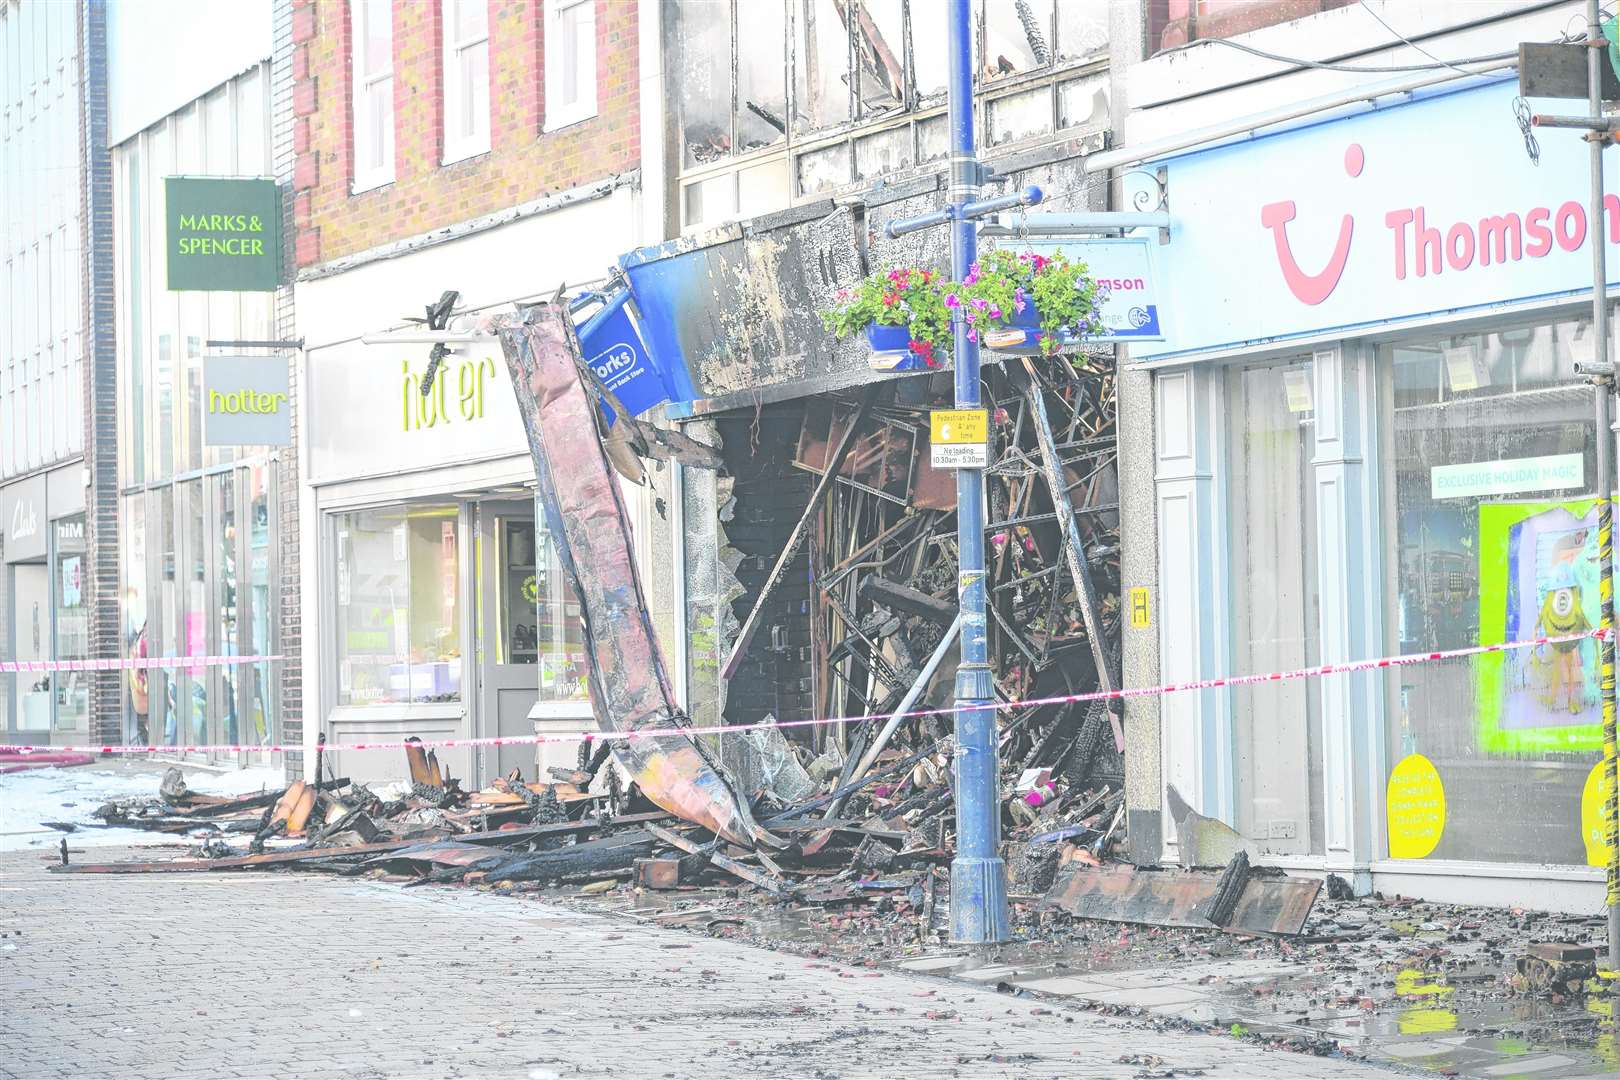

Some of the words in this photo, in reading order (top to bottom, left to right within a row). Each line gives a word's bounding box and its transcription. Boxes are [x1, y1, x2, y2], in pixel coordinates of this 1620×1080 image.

[179, 214, 246, 232] MARKS
[248, 215, 263, 232] &
[178, 238, 264, 256] SPENCER
[591, 351, 631, 378] orks
[208, 388, 287, 414] hotter
[1437, 472, 1493, 489] EXCLUSIVE
[1493, 468, 1540, 483] HOLIDAY
[1543, 464, 1578, 480] MAGIC
[1133, 592, 1147, 623] H
